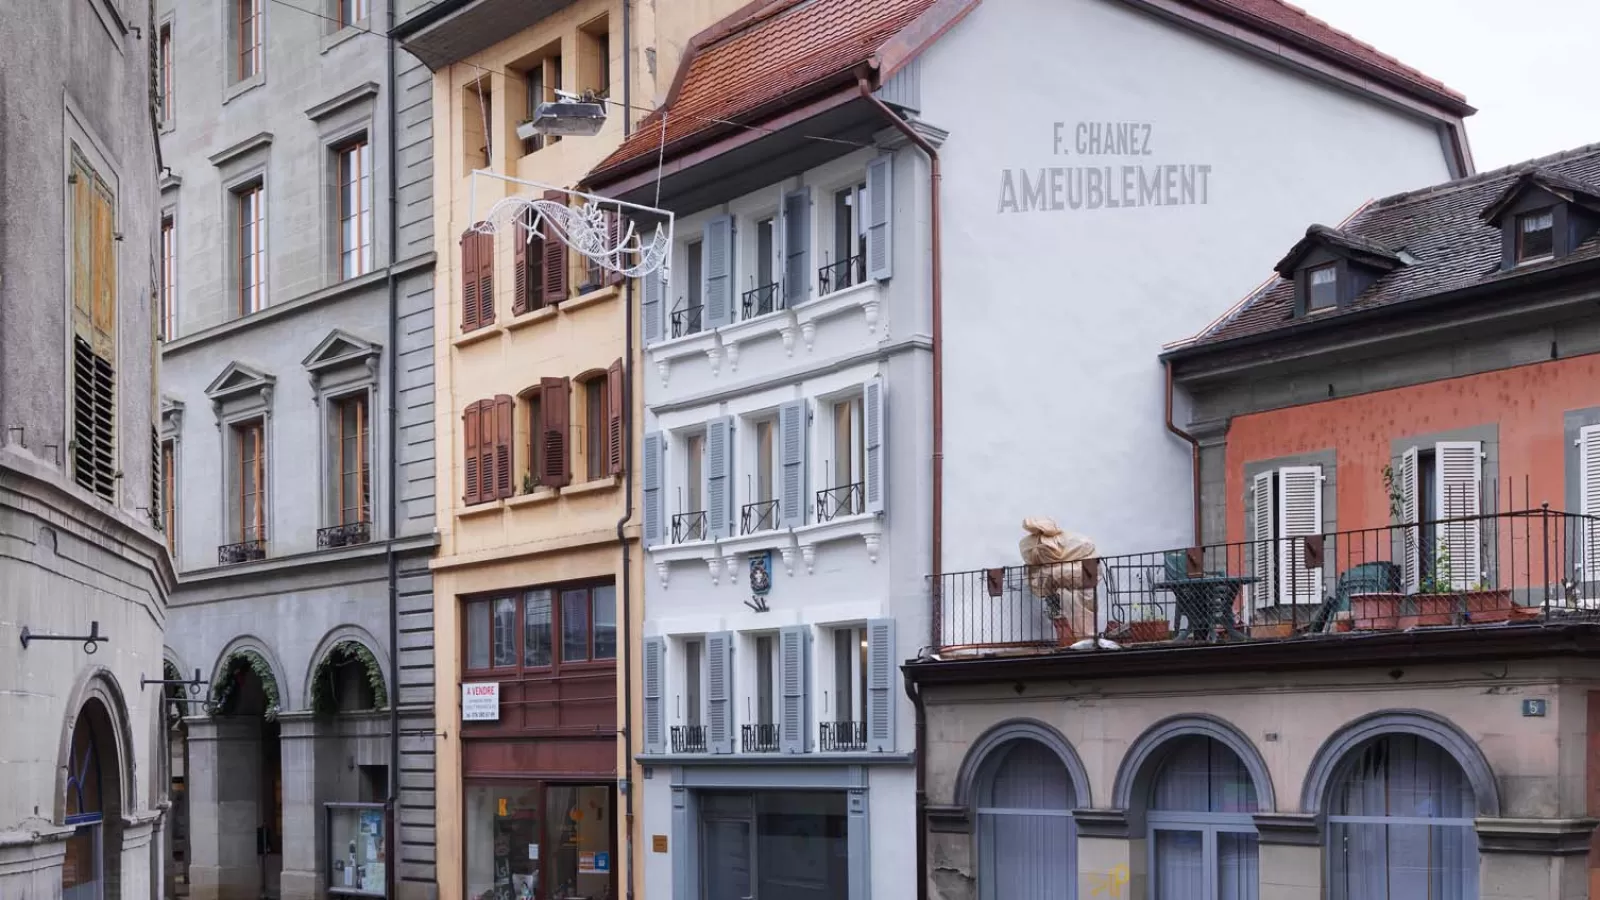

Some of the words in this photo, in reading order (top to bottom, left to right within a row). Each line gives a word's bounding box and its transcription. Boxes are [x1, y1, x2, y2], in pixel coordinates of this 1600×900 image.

[1053, 121, 1069, 155] F.
[1075, 121, 1153, 156] CHANEZ
[997, 164, 1212, 214] AMEUBLEMENT
[472, 685, 495, 696] VENDRE
[1529, 700, 1538, 714] 5
